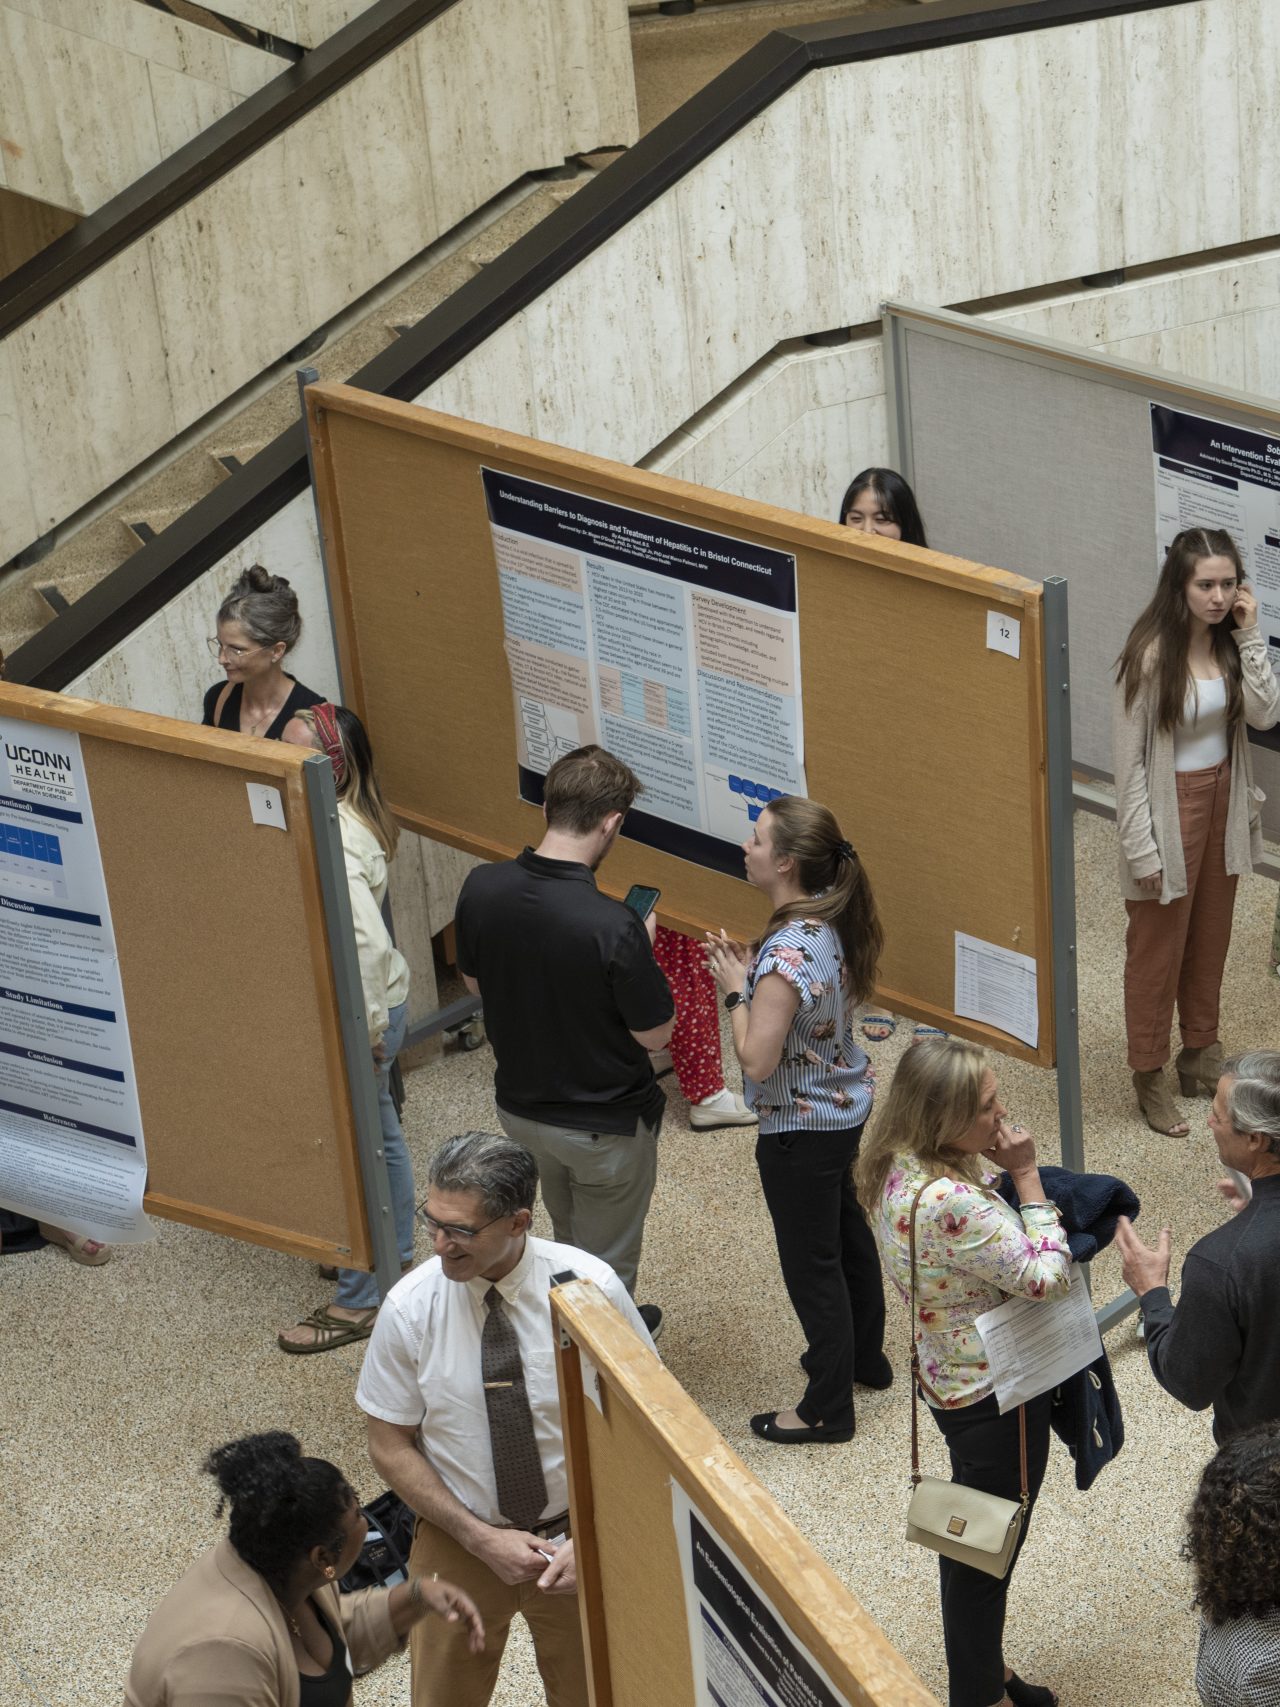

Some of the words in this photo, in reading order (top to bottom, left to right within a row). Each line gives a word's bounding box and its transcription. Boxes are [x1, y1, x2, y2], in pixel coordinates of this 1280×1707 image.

[1210, 438, 1220, 449] An
[1221, 442, 1263, 461] Intervention
[500, 489, 542, 511] Understanding
[544, 503, 568, 517] Barriers
[577, 513, 608, 530] Diagnosis
[609, 522, 621, 533] and
[622, 526, 654, 542] Treatment
[662, 538, 692, 555] Hepatitis
[707, 550, 730, 564] Bristol
[731, 557, 772, 577] Connecticut
[691, 592, 709, 605] Survey
[710, 598, 746, 615] Development
[1000, 628, 1010, 639] 12
[697, 669, 724, 683] Discussion
[725, 677, 735, 686] and
[736, 681, 782, 703] Recommendations
[5, 744, 71, 772] UCONN
[16, 764, 66, 783] HEALTH
[13, 780, 46, 791] DEPARTMENT
[42, 792, 66, 801] SCIENCES
[1, 898, 34, 912] Discussion
[5, 990, 24, 1002] Study
[26, 994, 64, 1010] Limitations
[28, 1050, 63, 1066] Conclusion
[43, 1113, 77, 1128] References
